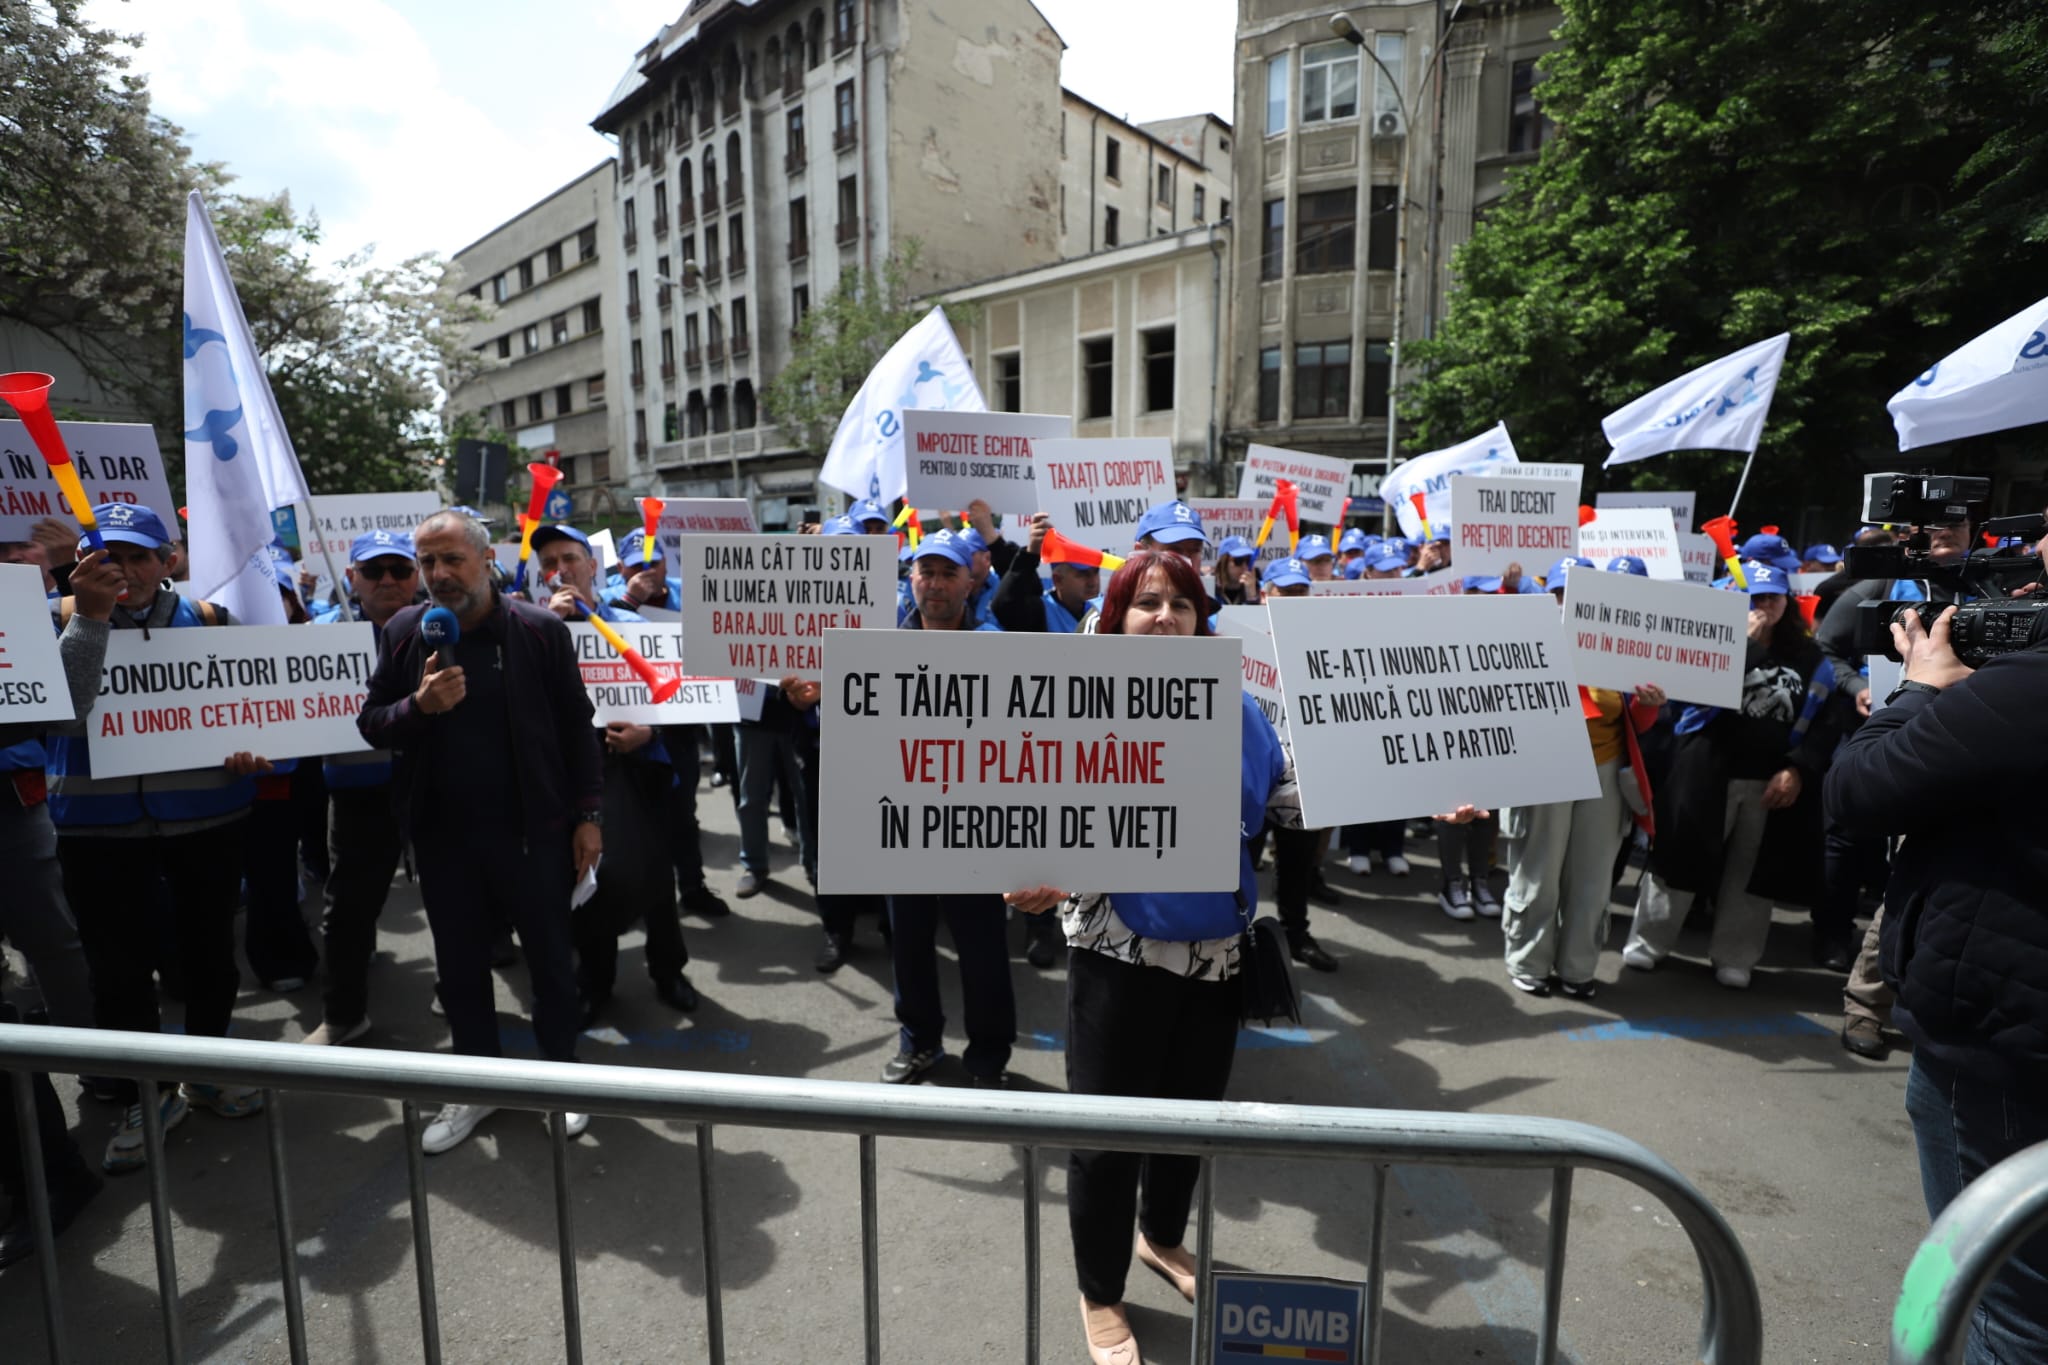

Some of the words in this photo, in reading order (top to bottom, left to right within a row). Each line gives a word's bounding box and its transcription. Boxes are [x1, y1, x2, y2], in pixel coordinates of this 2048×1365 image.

[916, 432, 979, 455] IMPOZITE
[984, 436, 1036, 459] ECHITA
[4, 449, 37, 480] ÎN
[100, 456, 149, 481] DAR
[919, 460, 957, 477] PENTRU
[960, 463, 967, 477] O
[970, 463, 1019, 480] SOCIETATE
[1047, 461, 1100, 494] TAXAȚI
[1103, 460, 1166, 491] CORUPȚIA
[1074, 501, 1095, 528] NU
[1478, 489, 1507, 514] TRAI
[1511, 490, 1556, 515] DECENT
[340, 517, 357, 530] CA
[1462, 524, 1513, 553] PREȚURI
[1518, 525, 1572, 549] DECENTE!
[705, 546, 755, 571] DIANA
[761, 542, 796, 571] CÂT
[802, 547, 823, 571] TU
[830, 546, 871, 572] STAI
[701, 575, 718, 603] ÎN
[724, 578, 778, 604] LUMEA
[785, 576, 875, 608] VIRTUALĂ,
[712, 611, 788, 637] BARAJUL
[1575, 602, 1596, 621] NOI
[1599, 602, 1612, 624] ÎN
[1615, 608, 1642, 629] FRIG
[1645, 613, 1658, 633] ȘI
[1660, 615, 1737, 646] INTERVENȚII,
[640, 637, 665, 660] DE
[728, 643, 779, 673] VIAȚA
[1306, 648, 1377, 686] NE-AȚI
[1381, 644, 1463, 676] INUNDAT
[1466, 641, 1549, 672] LOCURILE
[1577, 631, 1597, 650] VOI
[1600, 631, 1614, 652] ÎN
[1616, 637, 1653, 660] BIROU
[1656, 644, 1673, 662] CU
[1675, 647, 1731, 673] INVENȚII!
[99, 654, 278, 697] CONDUCĂTORI
[286, 652, 372, 687] BOGAȚI
[0, 682, 47, 706] ESC
[843, 672, 880, 716] CE
[895, 664, 990, 729] TĂIAȚI
[1007, 674, 1056, 719] AZI
[1068, 675, 1115, 720] DIN
[1127, 677, 1219, 720] BUGET
[1298, 694, 1327, 726] DE
[1332, 684, 1402, 724] MUNCĂ
[1406, 689, 1434, 718] CU
[1439, 680, 1571, 717] INCOMPETENȚII
[101, 712, 124, 737] AI
[132, 706, 193, 735] UNOR
[201, 697, 297, 729] CETĂȚENI
[303, 692, 367, 719] SĂRAC
[899, 738, 965, 795] VEȚI
[979, 730, 1063, 784] PLĂTI
[1075, 731, 1166, 784] MÂINE
[1381, 734, 1409, 766] DE
[1412, 732, 1439, 763] LA
[1443, 726, 1518, 761] PARTID!
[878, 796, 909, 849] ÎN
[922, 805, 1047, 849] PIERDERI
[1060, 805, 1096, 849] DE
[1108, 805, 1178, 860] VIEȚI
[1221, 1303, 1350, 1344] DGJMB
